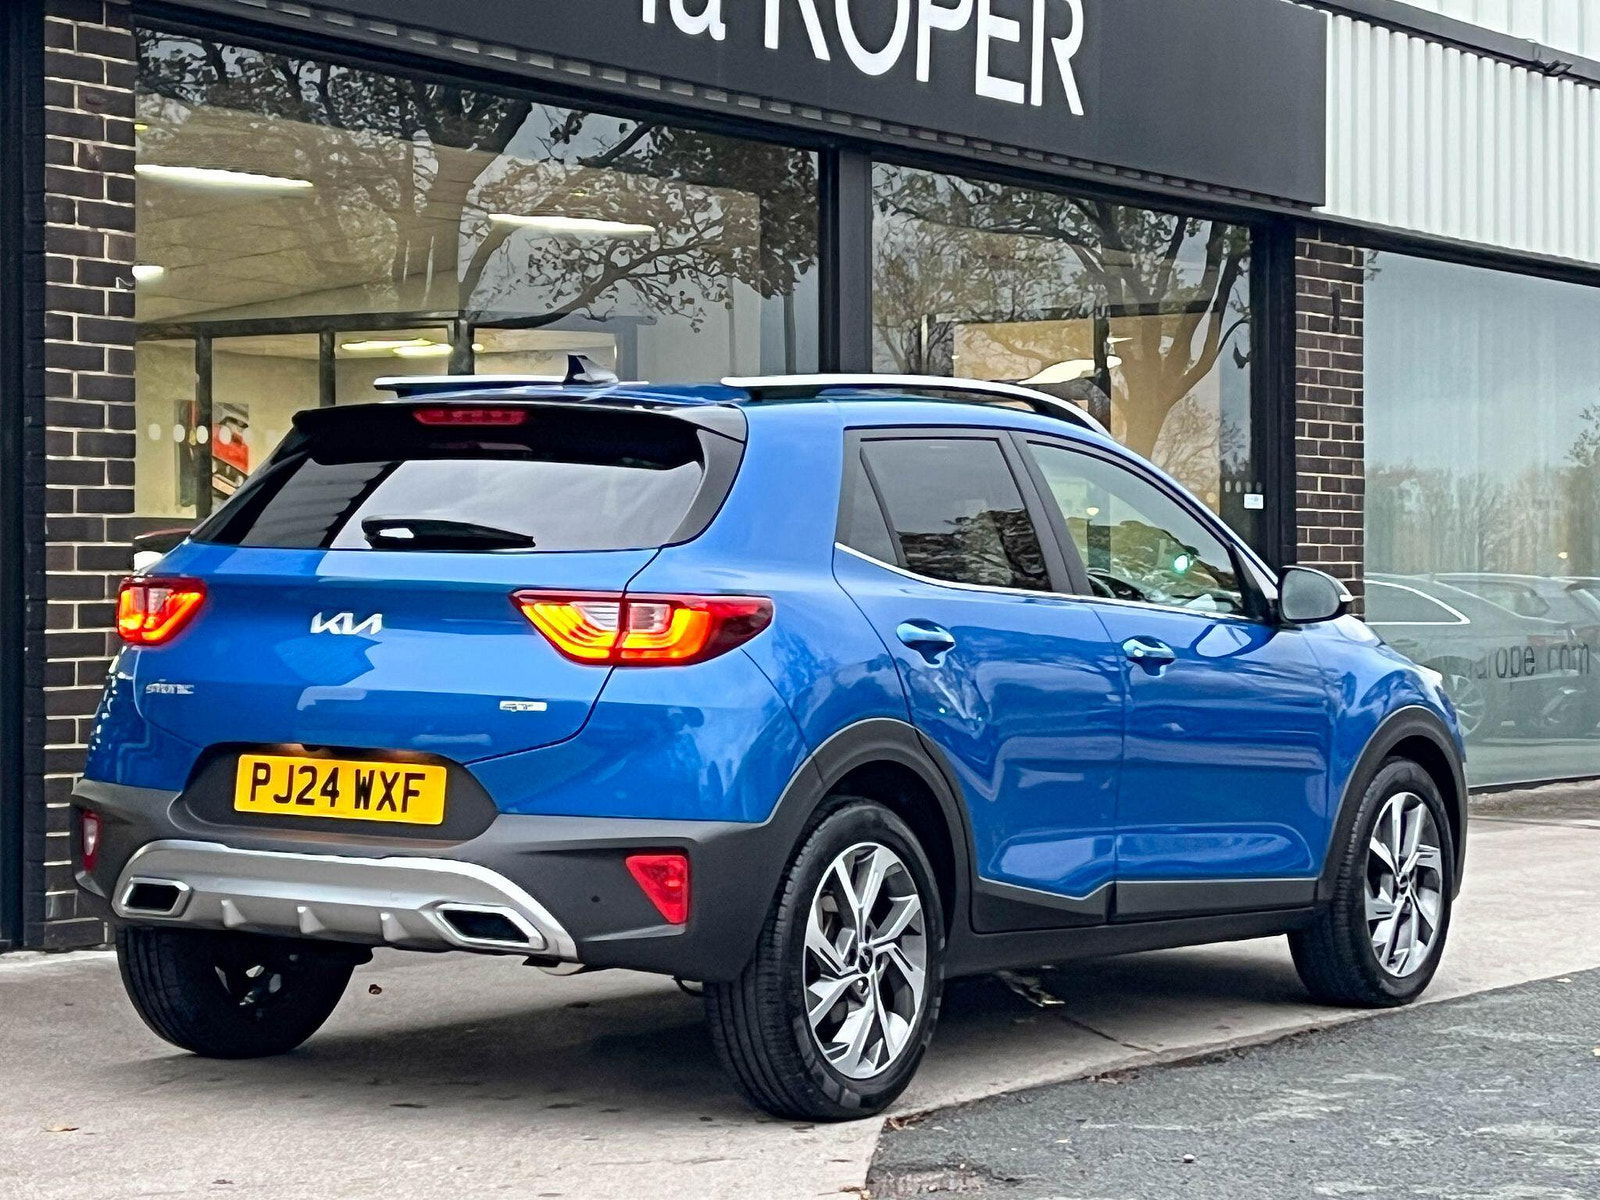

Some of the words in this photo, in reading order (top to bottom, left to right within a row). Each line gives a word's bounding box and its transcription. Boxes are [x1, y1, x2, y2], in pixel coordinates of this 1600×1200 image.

[642, 0, 727, 41] a
[309, 611, 383, 635] KIA
[249, 761, 340, 808] PJ24
[353, 768, 426, 814] WXF
